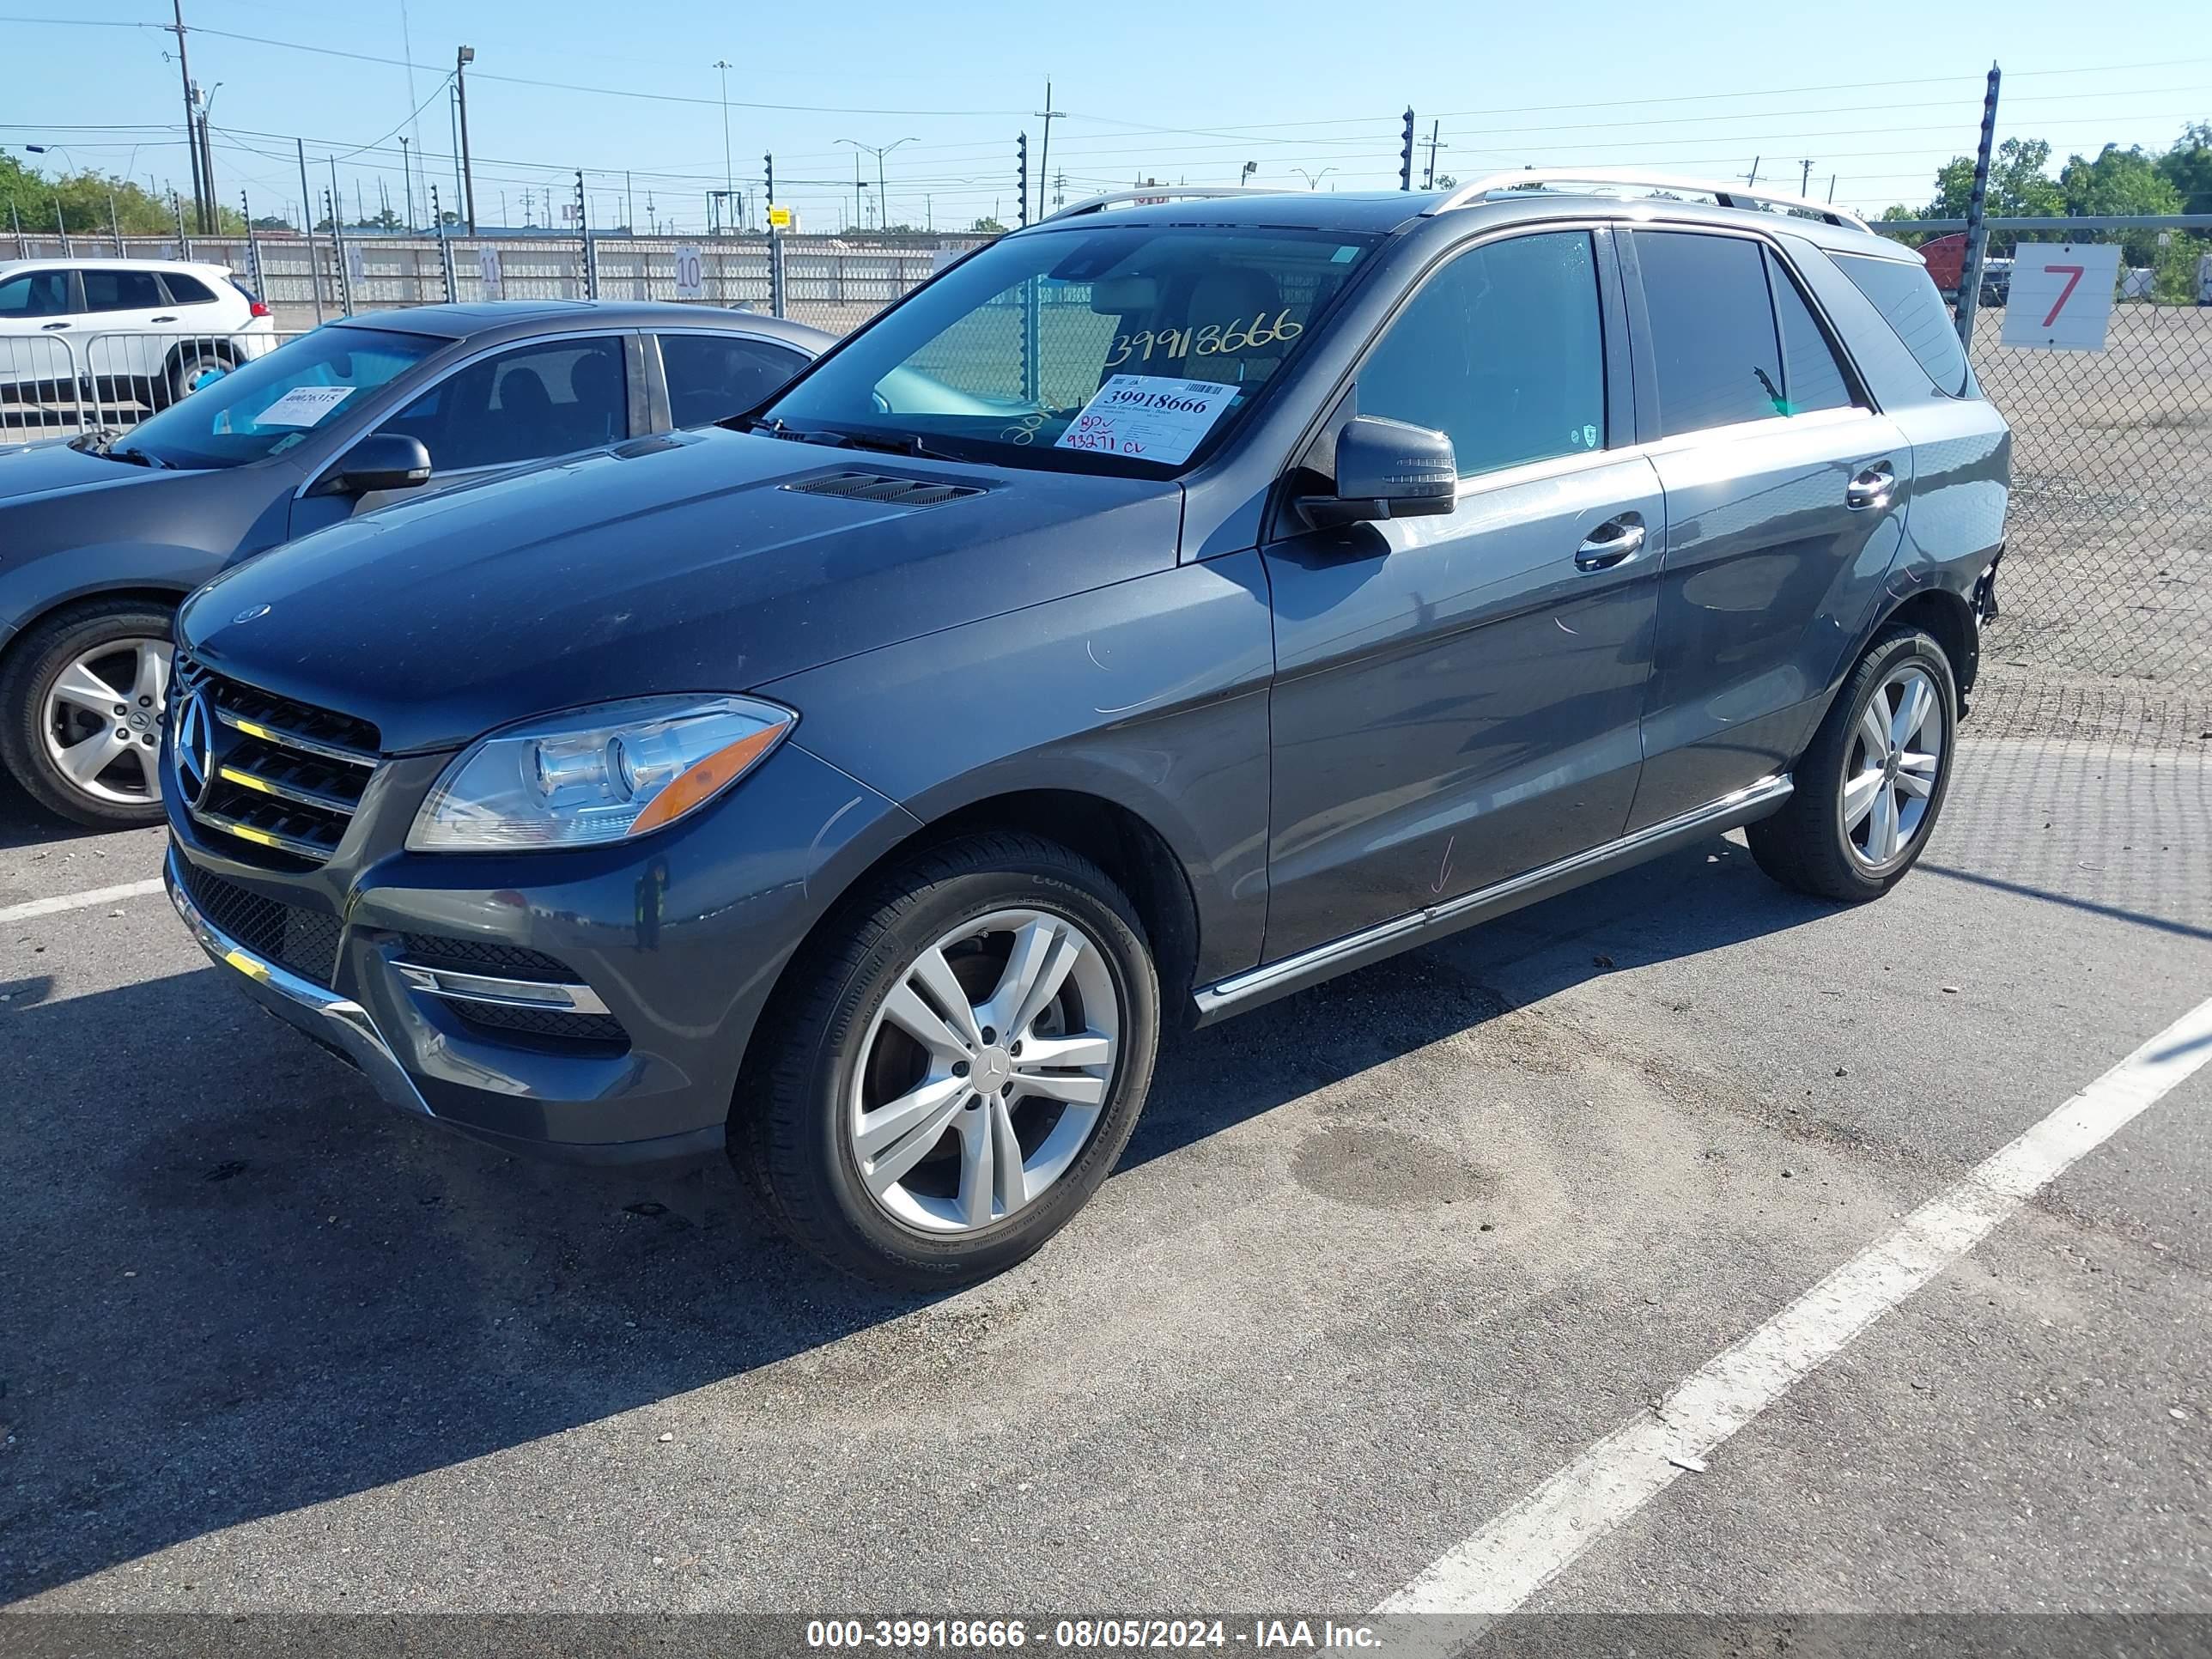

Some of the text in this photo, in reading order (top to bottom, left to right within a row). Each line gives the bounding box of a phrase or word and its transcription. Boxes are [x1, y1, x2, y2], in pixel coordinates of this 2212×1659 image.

[482, 256, 499, 283] 11
[677, 256, 701, 289] 10
[2041, 264, 2085, 327] 7
[1104, 308, 1304, 367] 39918666
[1103, 390, 1212, 414] 39918666
